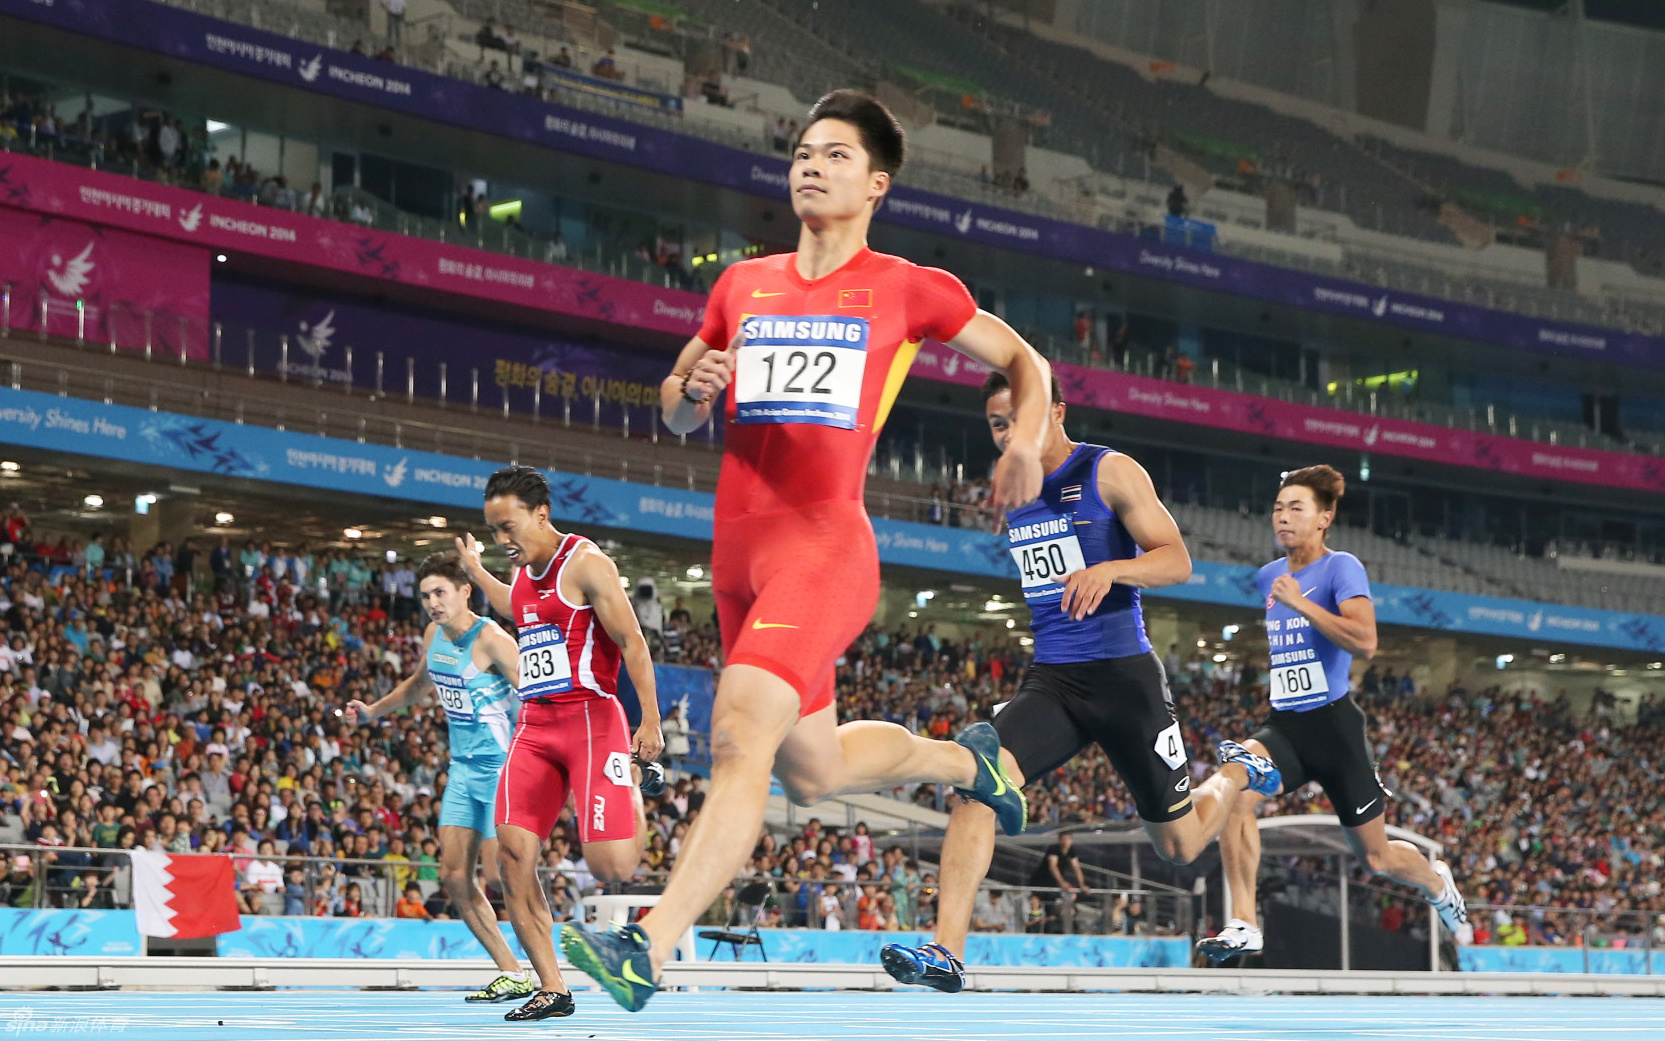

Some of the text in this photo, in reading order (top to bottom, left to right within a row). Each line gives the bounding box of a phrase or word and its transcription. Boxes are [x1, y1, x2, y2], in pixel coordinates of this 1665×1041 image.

[328, 64, 411, 96] INCHEON 2014
[209, 213, 296, 242] INCHEON 2014
[653, 299, 695, 325] Diversity
[744, 320, 862, 342] SAMSUNG
[762, 351, 837, 394] 122
[0, 406, 128, 440] versity Shines Here
[414, 467, 486, 490] INCHEON 20
[1008, 518, 1068, 543] SAMSUNG
[1022, 543, 1067, 581] 450
[1268, 632, 1305, 646] CHINA
[1278, 667, 1312, 694] 160
[1168, 734, 1178, 758] 4
[612, 757, 623, 779] 6
